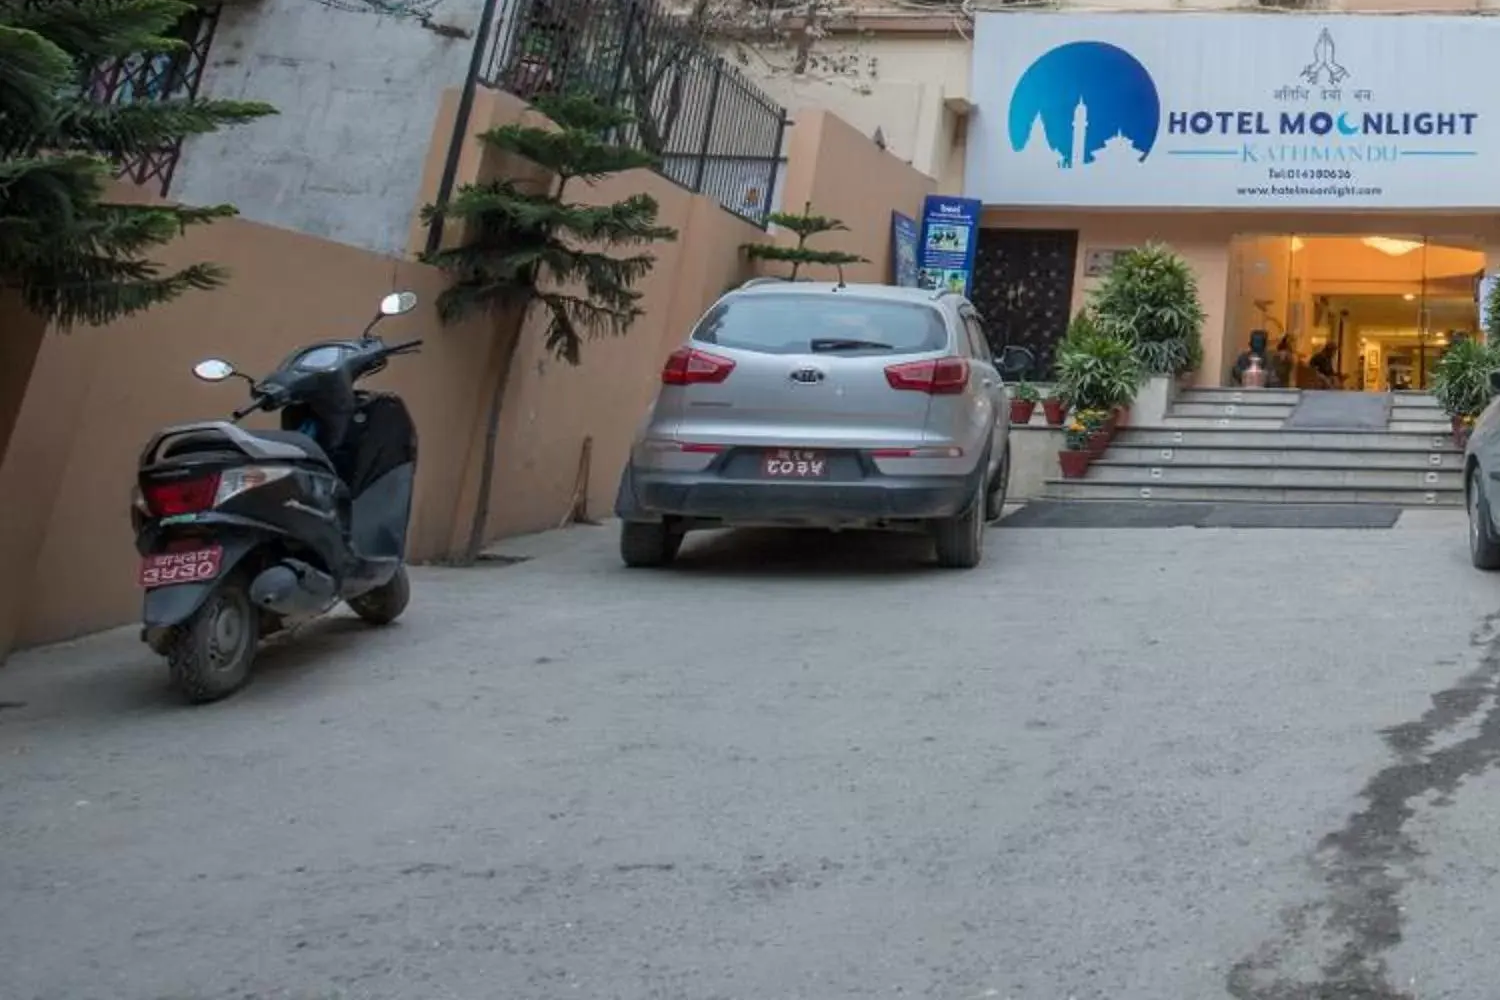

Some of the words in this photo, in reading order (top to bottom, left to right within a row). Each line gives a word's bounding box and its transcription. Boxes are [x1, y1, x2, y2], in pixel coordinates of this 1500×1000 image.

[1168, 111, 1270, 135] HOTEL
[1279, 110, 1478, 136] MOONLIGHT
[1242, 143, 1398, 163] KATHMANDU
[1236, 185, 1383, 197] www.hotelmoonlight.com
